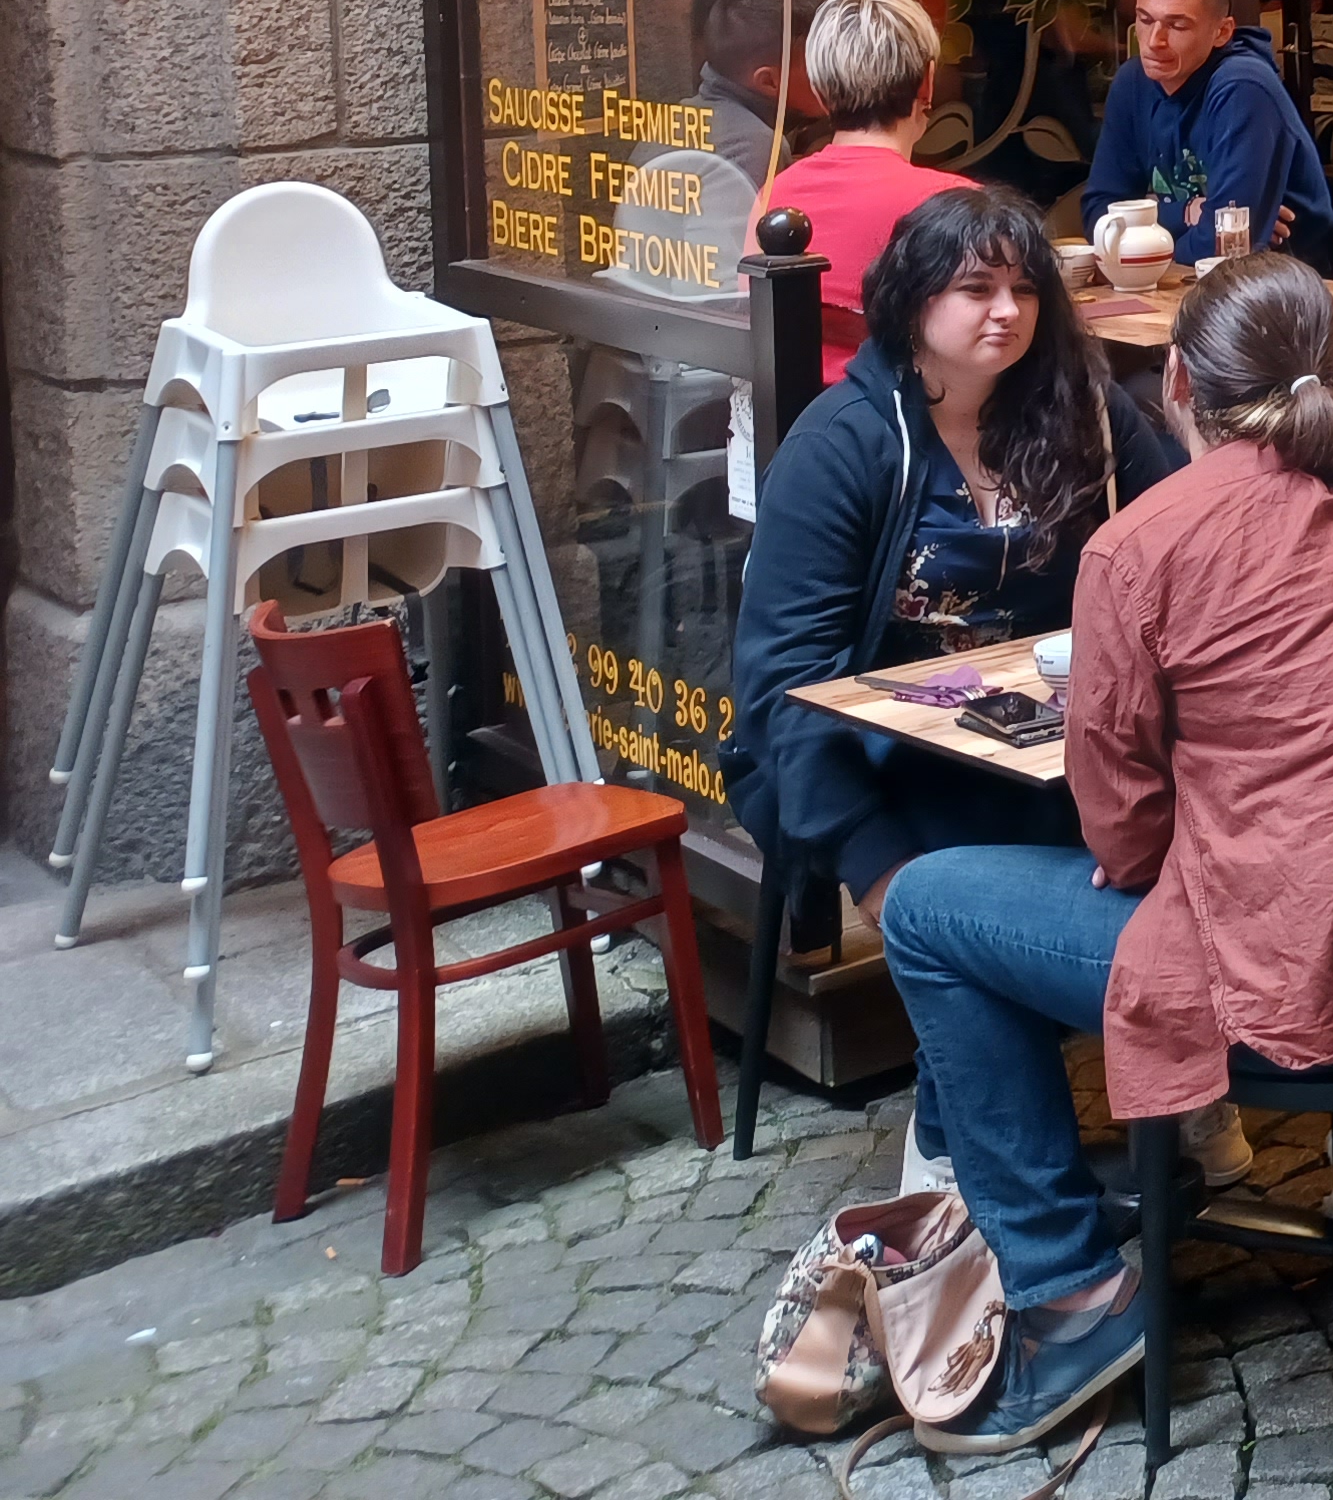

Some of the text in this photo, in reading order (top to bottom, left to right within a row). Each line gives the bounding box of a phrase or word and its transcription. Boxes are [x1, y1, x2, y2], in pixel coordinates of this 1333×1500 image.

[488, 77, 714, 152] SAUCISSE FERMIERE
[502, 140, 702, 217] CIDRE FERMIER
[492, 200, 720, 289] BIERE BRETONNE
[587, 643, 619, 695] 99
[628, 658, 664, 714] 40
[674, 679, 708, 734] 36
[718, 696, 734, 742] 2
